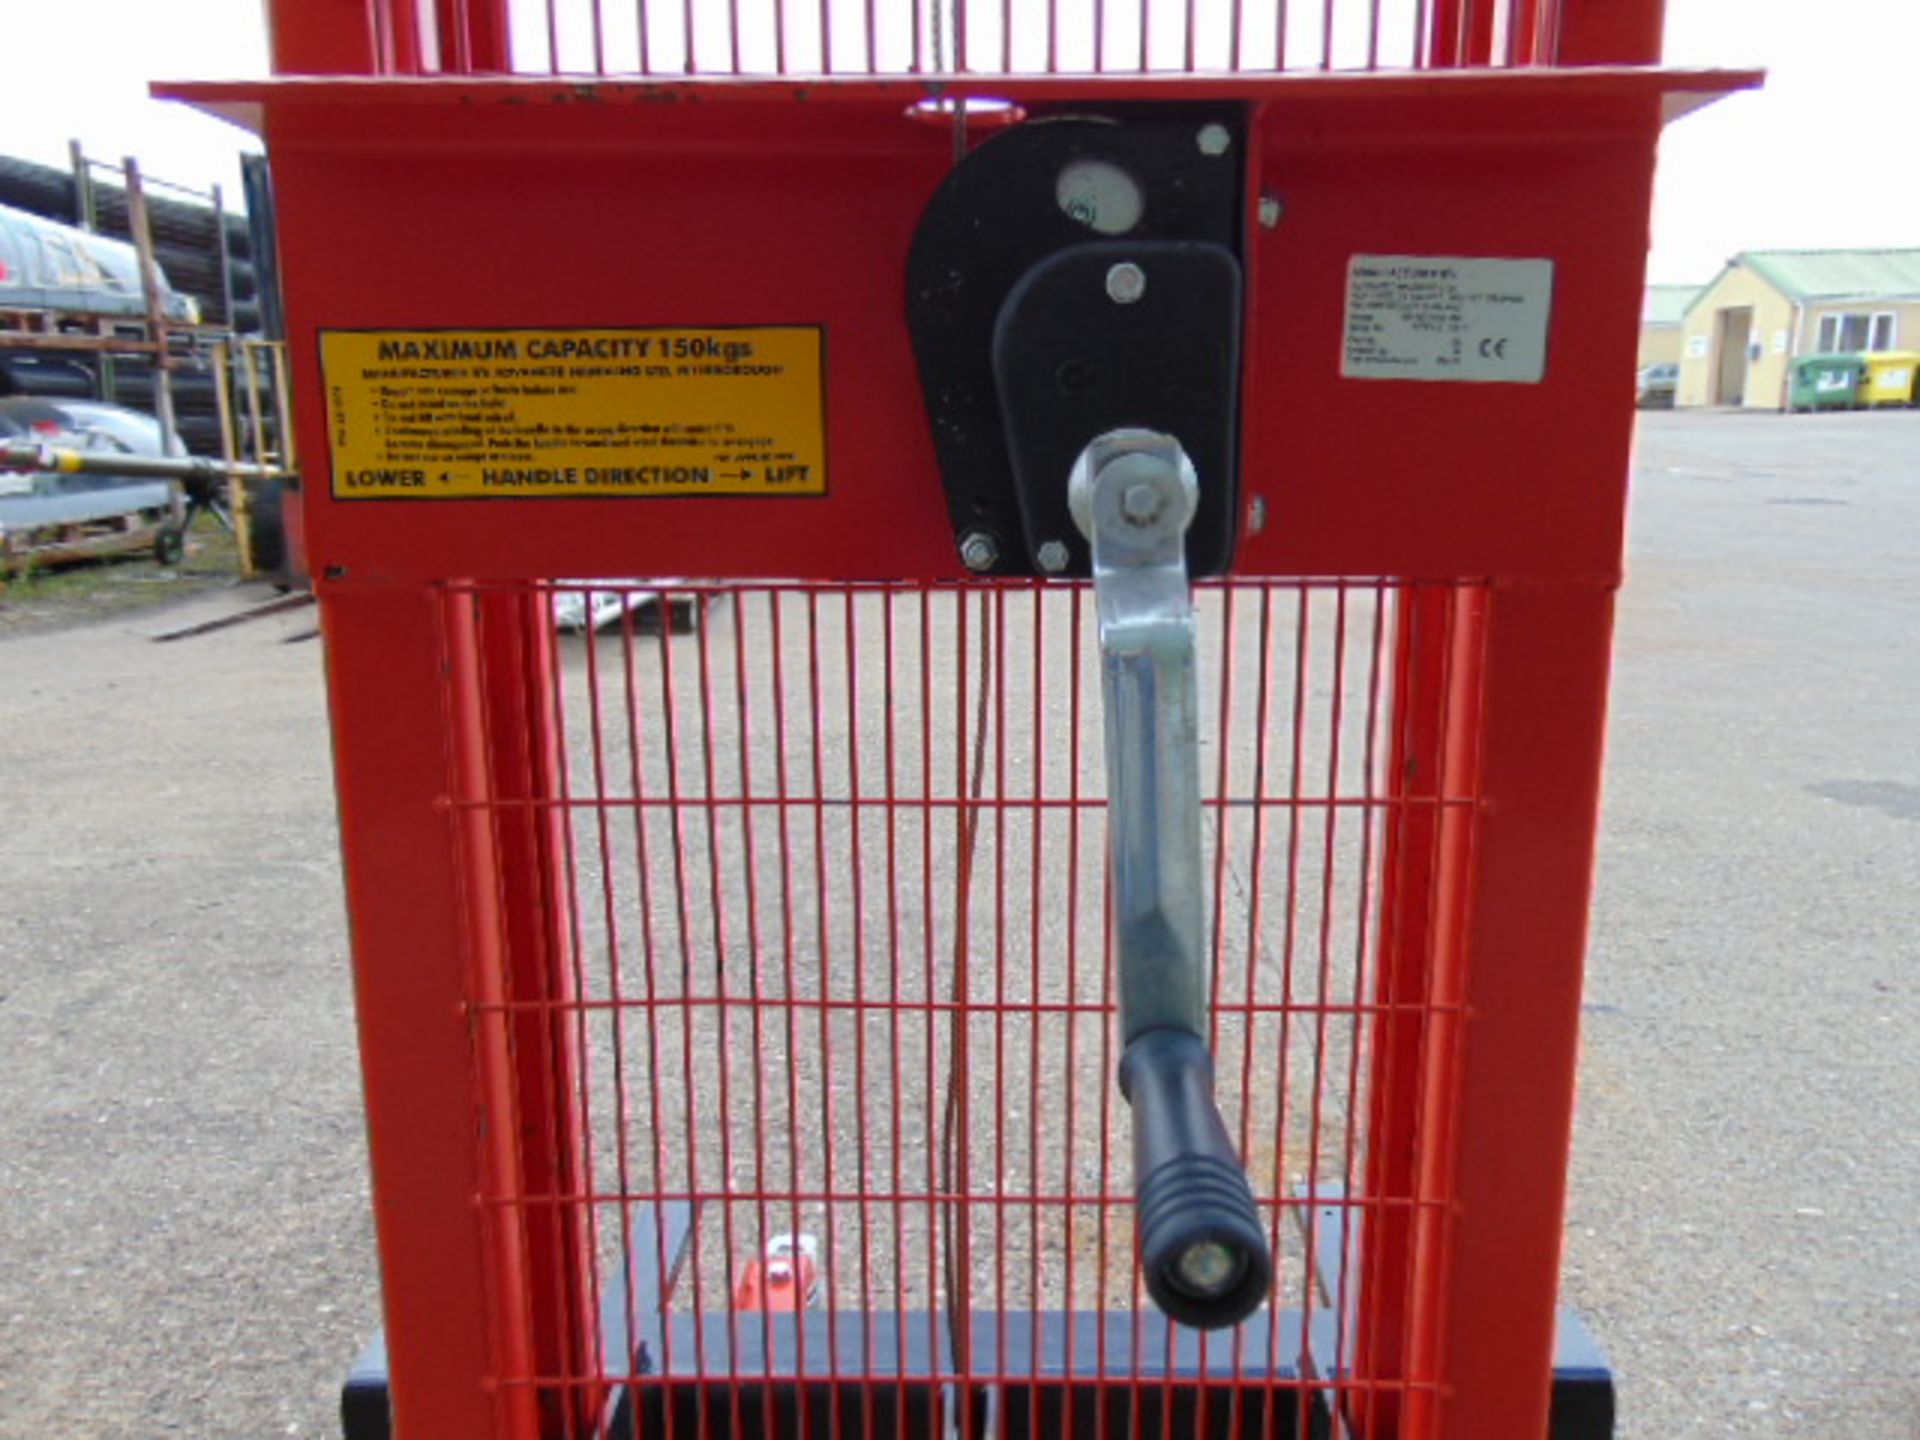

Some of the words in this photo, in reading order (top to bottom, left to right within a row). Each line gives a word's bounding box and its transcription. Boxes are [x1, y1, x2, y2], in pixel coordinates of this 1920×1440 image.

[378, 339, 517, 360] MAXIMUM
[526, 337, 649, 359] CAPACITY
[659, 336, 753, 361] 150kgs
[346, 470, 426, 487] LOWER
[482, 468, 578, 487] HANDLE
[584, 467, 710, 485] DIRECTION
[764, 465, 809, 484] LIFT
